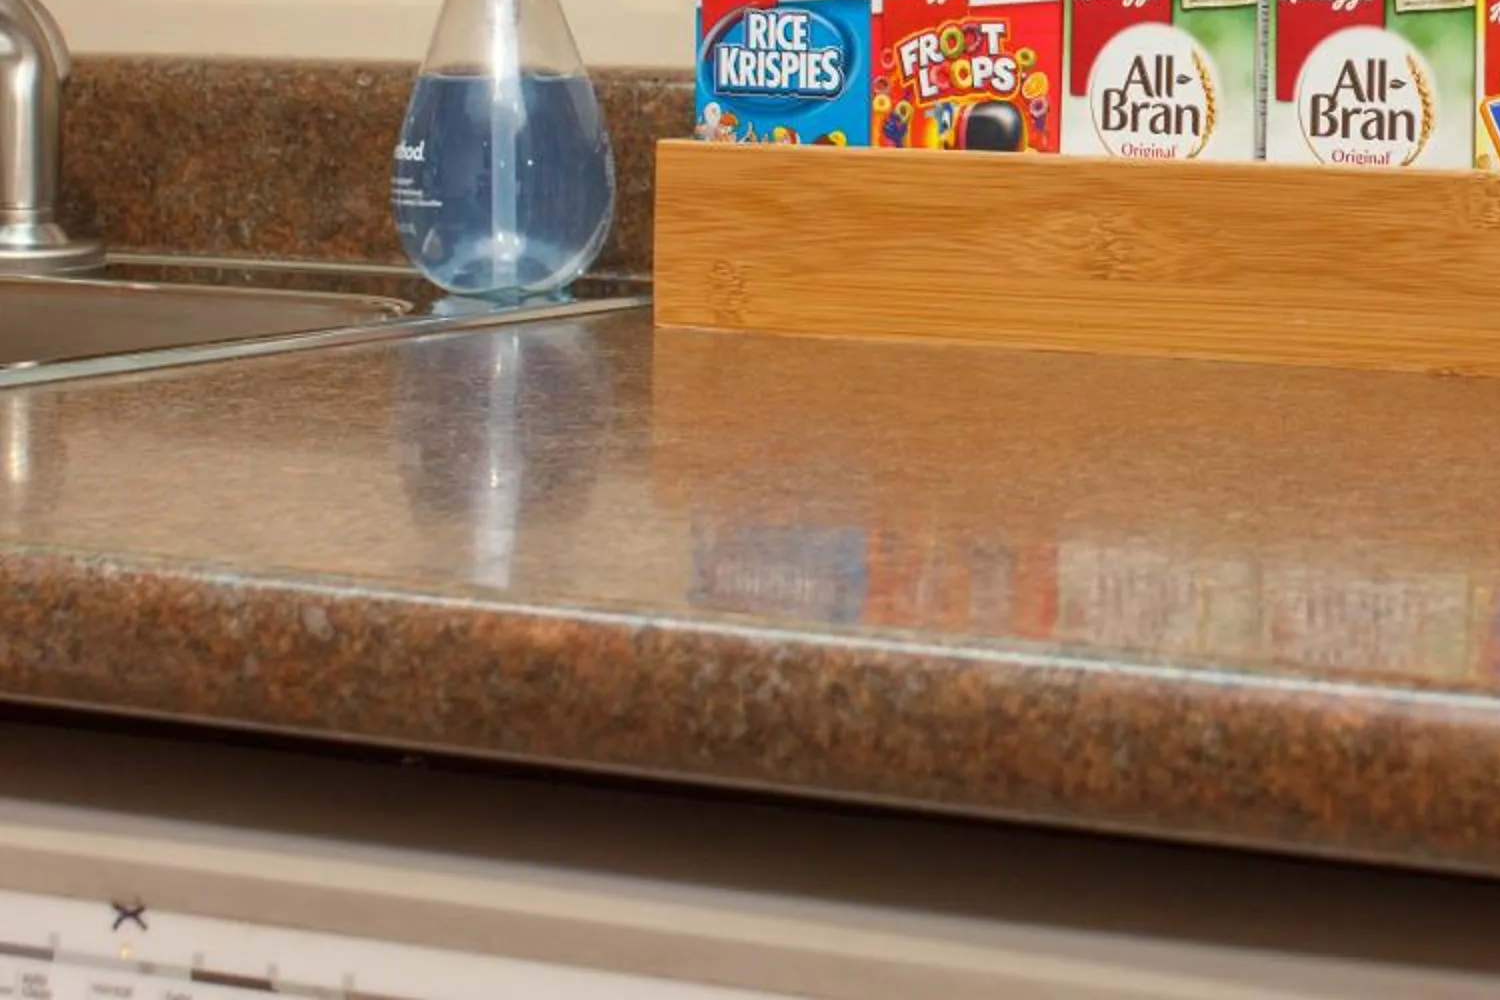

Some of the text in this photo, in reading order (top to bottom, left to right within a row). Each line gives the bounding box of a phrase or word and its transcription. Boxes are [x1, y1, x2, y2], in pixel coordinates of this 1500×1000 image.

[748, 12, 808, 51] RICE
[900, 23, 1005, 77] FROOT
[719, 50, 842, 92] KRISPIES
[919, 56, 1016, 97] LOOPS
[1101, 88, 1200, 136] Bran
[1309, 94, 1415, 142] Bran
[1331, 149, 1391, 165] Original
